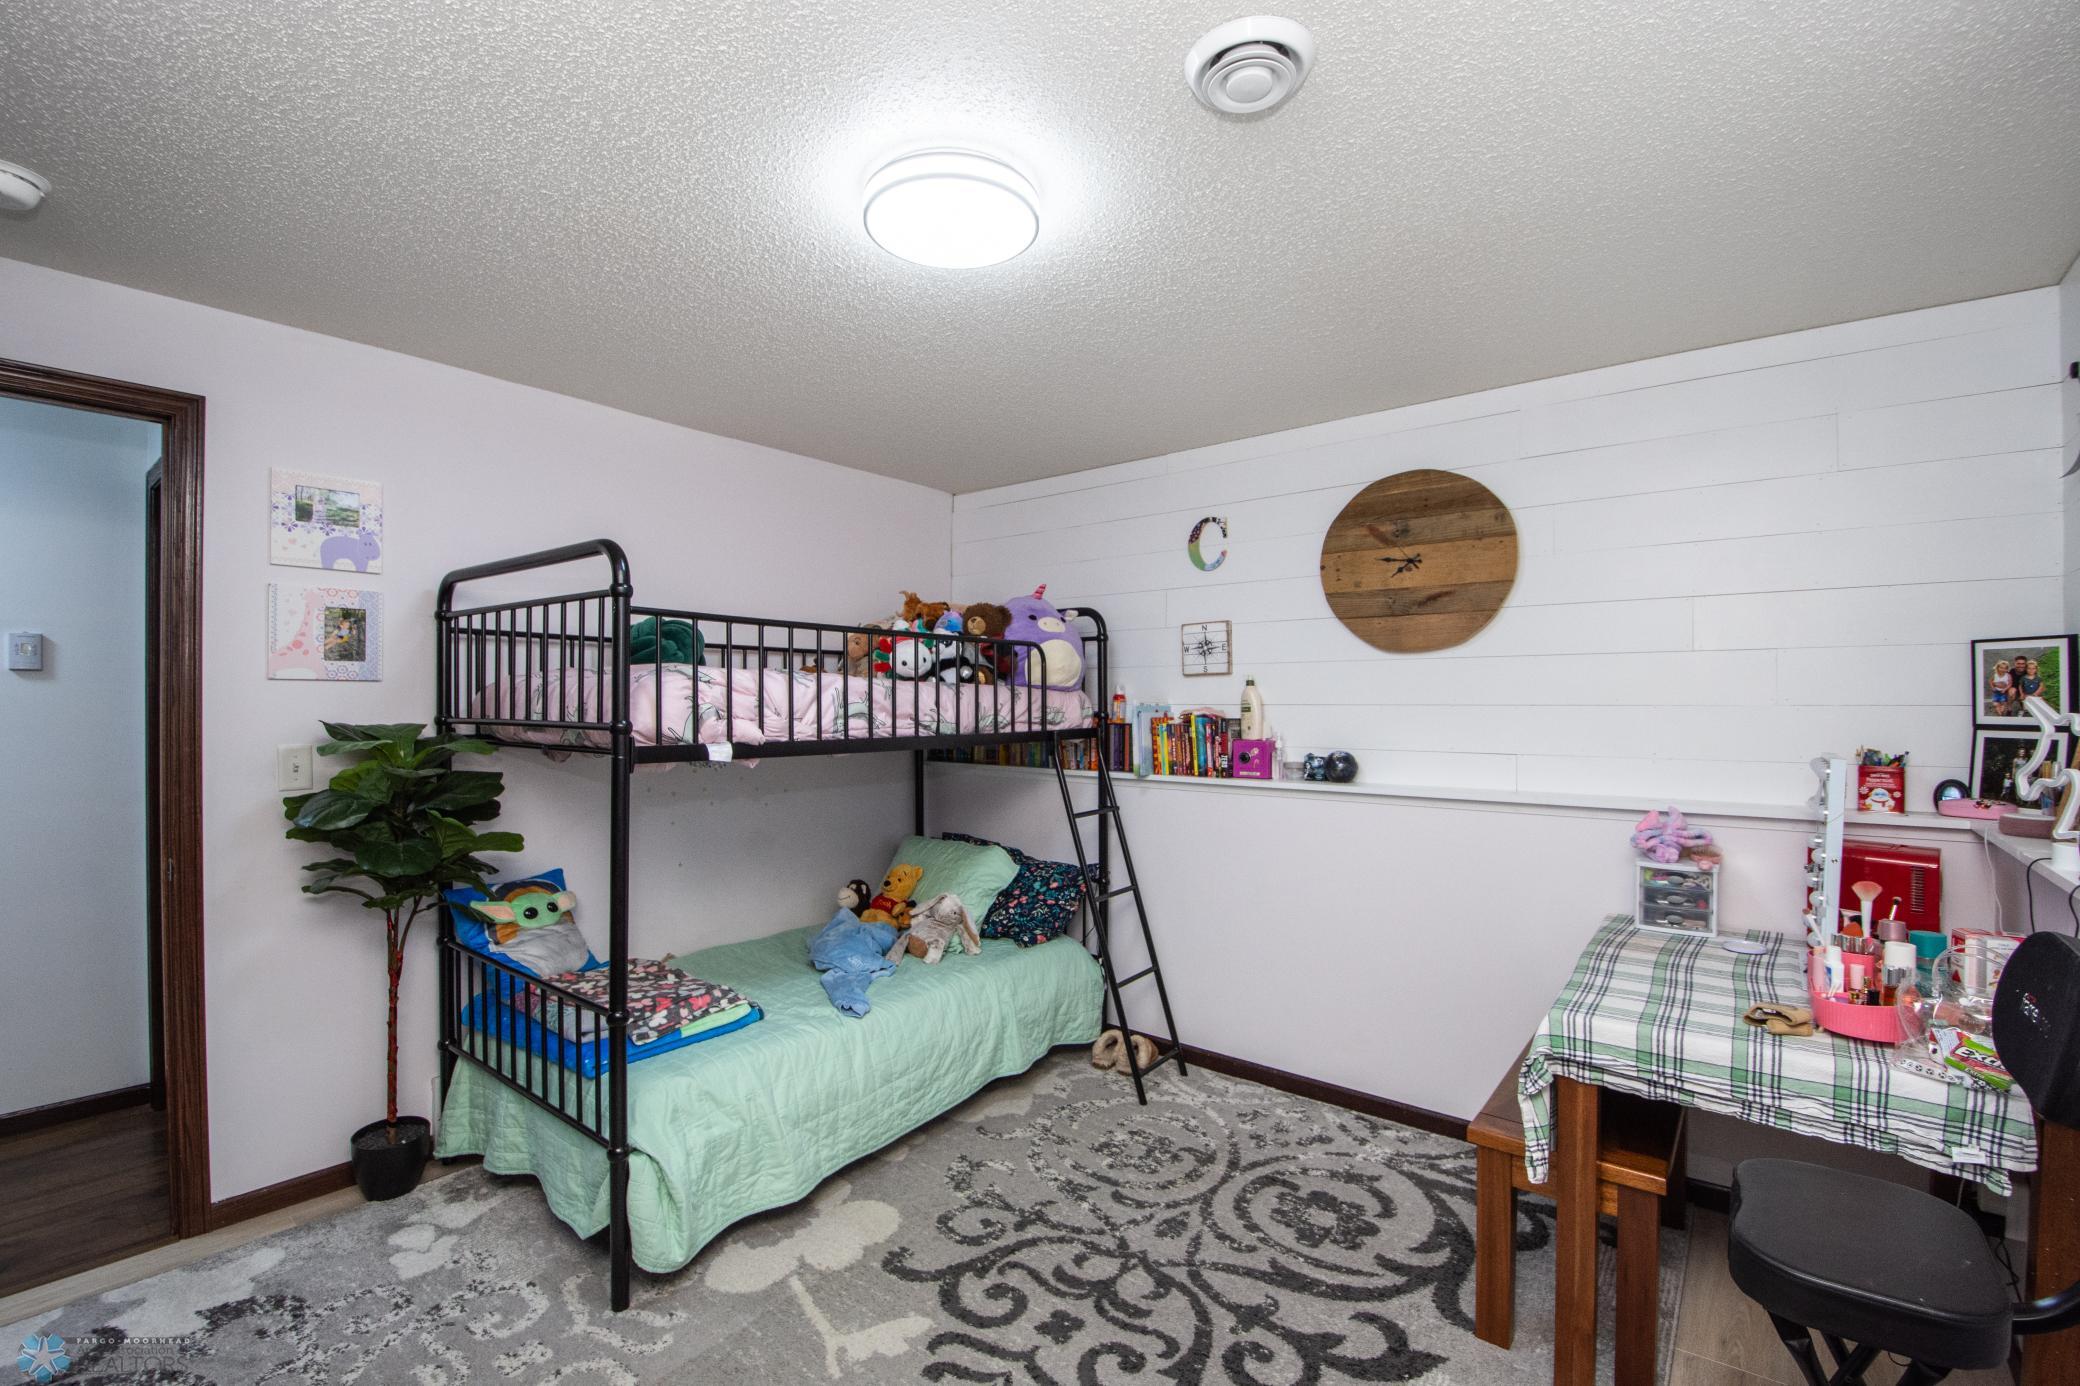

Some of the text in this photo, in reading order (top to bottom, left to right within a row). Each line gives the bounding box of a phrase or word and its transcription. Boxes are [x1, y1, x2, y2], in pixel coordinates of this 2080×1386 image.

[1188, 516, 1228, 572] C
[1221, 643, 1227, 651] E
[1203, 665, 1209, 673] S
